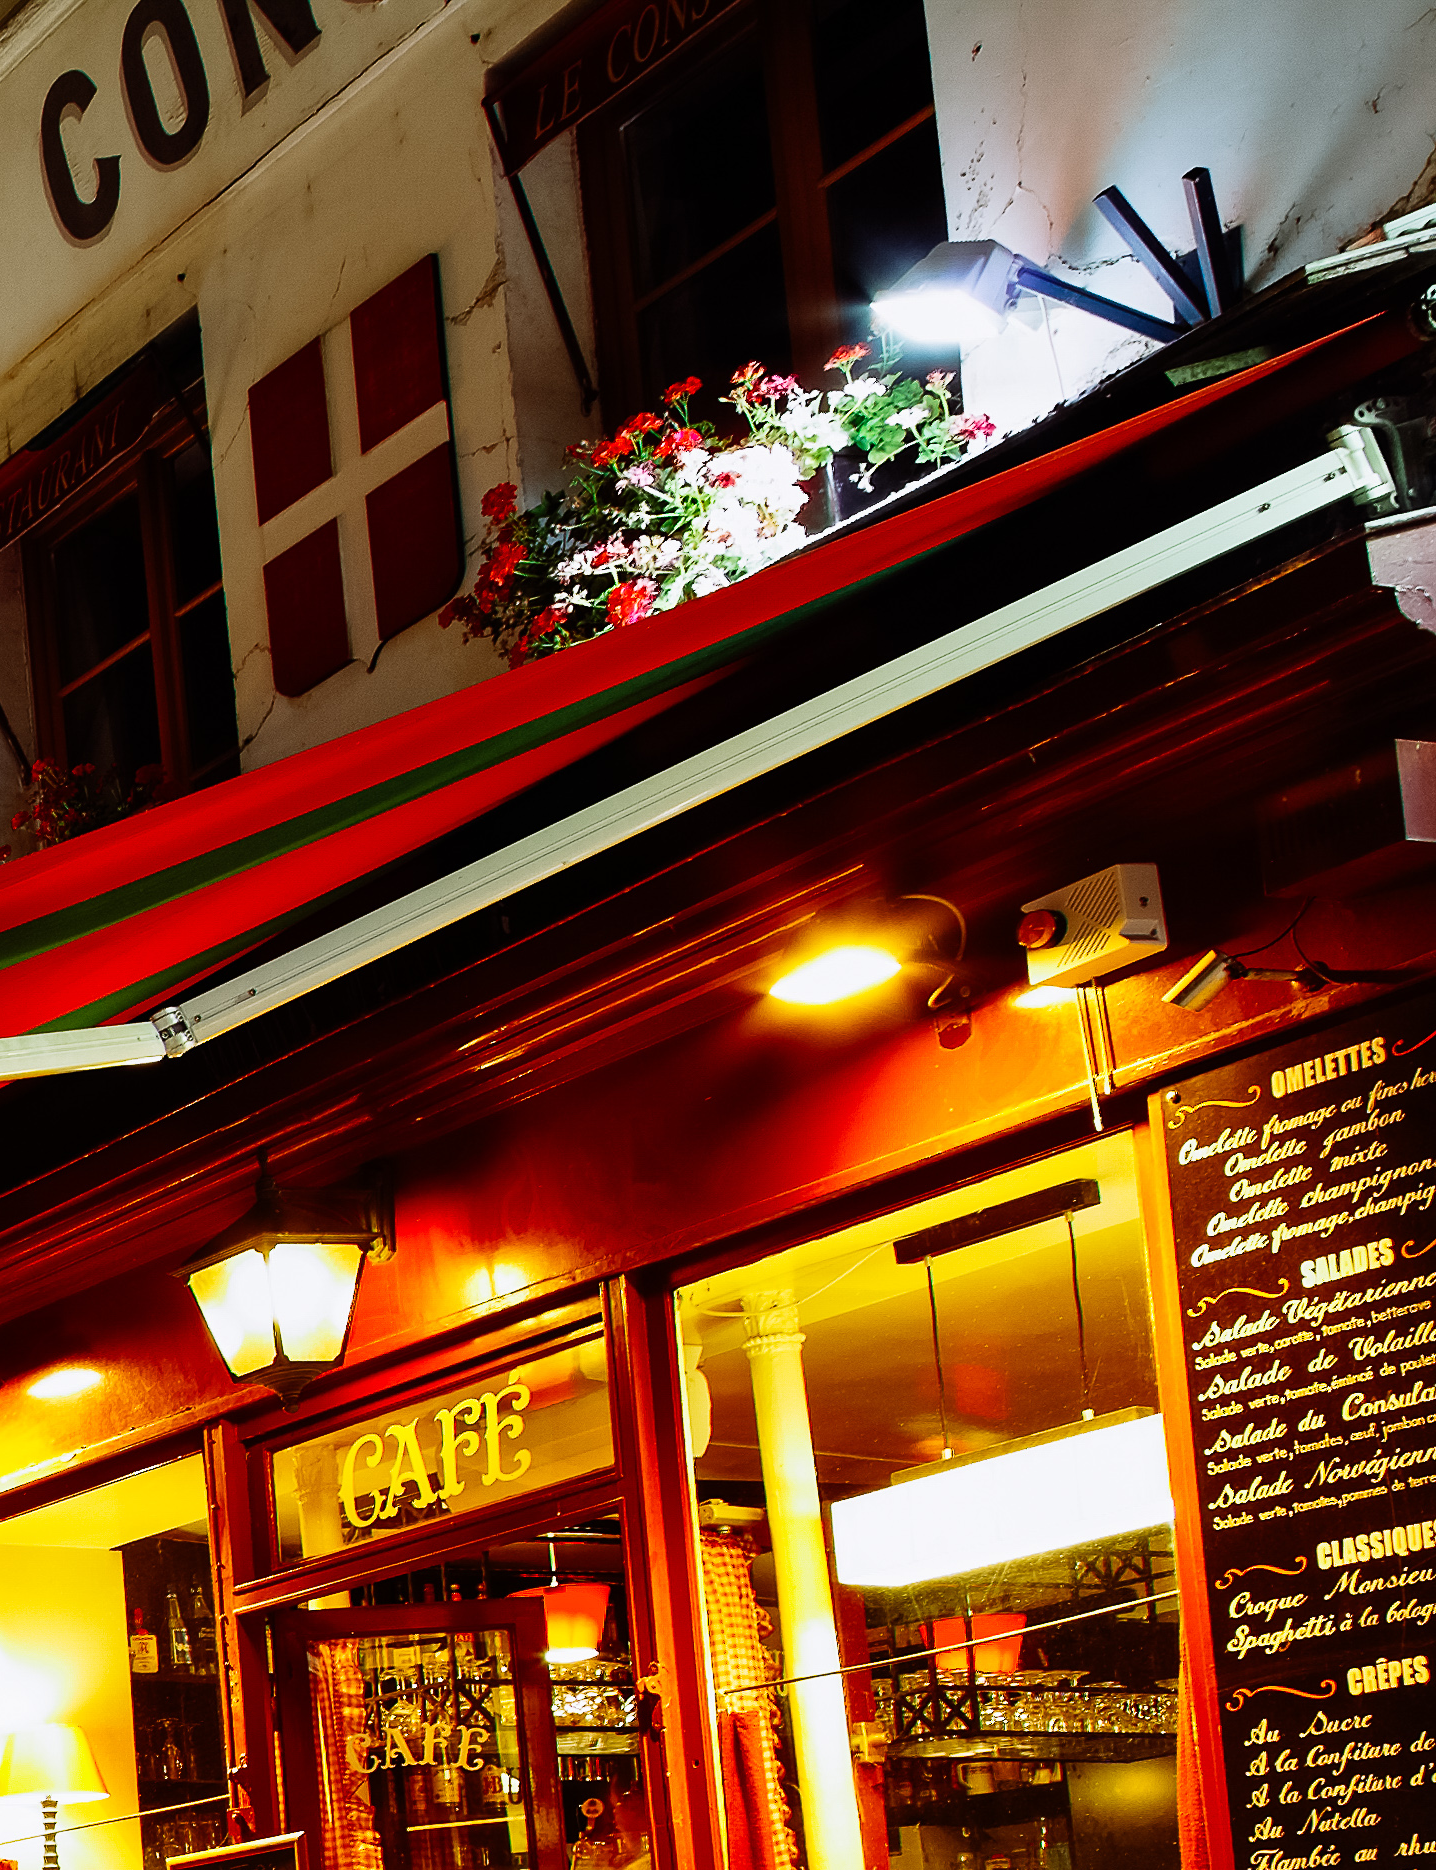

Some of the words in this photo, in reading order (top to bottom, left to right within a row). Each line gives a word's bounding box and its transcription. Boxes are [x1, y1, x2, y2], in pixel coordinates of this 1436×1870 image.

[535, 58, 582, 140] LE
[1270, 1036, 1387, 1099] OMELETTES
[1178, 1126, 1258, 1166] Omelette
[1260, 1104, 1338, 1149] fromage
[1341, 1095, 1364, 1113] ou
[1366, 1079, 1408, 1113] fines
[1224, 1138, 1307, 1177] Omelette
[1229, 1164, 1313, 1202] Omelette
[1329, 1140, 1388, 1172] mixte
[1206, 1196, 1290, 1237] Omelette
[1299, 1157, 1436, 1209] champignon
[1191, 1231, 1270, 1268] Omelette
[1299, 1237, 1395, 1289] SALADES
[1192, 1309, 1280, 1351] Salade
[1195, 1349, 1238, 1371] Salade
[1198, 1359, 1292, 1402] Salade
[1308, 1348, 1338, 1373] de
[338, 1369, 532, 1529] CAFÉ
[1204, 1417, 1288, 1456] Salade
[1298, 1409, 1326, 1433] du
[1208, 1470, 1294, 1510] Salade
[1303, 1447, 1436, 1489] Norvégienn
[1212, 1512, 1254, 1531] Salade
[1391, 1479, 1406, 1492] de
[1316, 1520, 1436, 1570] CLASSIQUE
[1228, 1591, 1309, 1622] Croque
[1323, 1567, 1436, 1601] Monsieu
[1225, 1614, 1337, 1659] Spaghetti
[1339, 1613, 1354, 1631] à
[1358, 1606, 1380, 1627] la
[1347, 1655, 1431, 1696] CRÊPES
[1244, 1719, 1281, 1746] Au
[1299, 1710, 1373, 1738] Sucre
[1245, 1751, 1270, 1776] A
[1275, 1749, 1298, 1772] la
[1305, 1741, 1402, 1776] Confiture
[1410, 1730, 1436, 1753] de
[1246, 1783, 1270, 1809] A
[1279, 1781, 1302, 1804] la
[1307, 1773, 1403, 1806] Confiture
[1248, 1816, 1285, 1843] Au
[1297, 1806, 1382, 1835] Nutella
[1354, 1846, 1378, 1863] au
[1394, 1834, 1436, 1856] rhu
